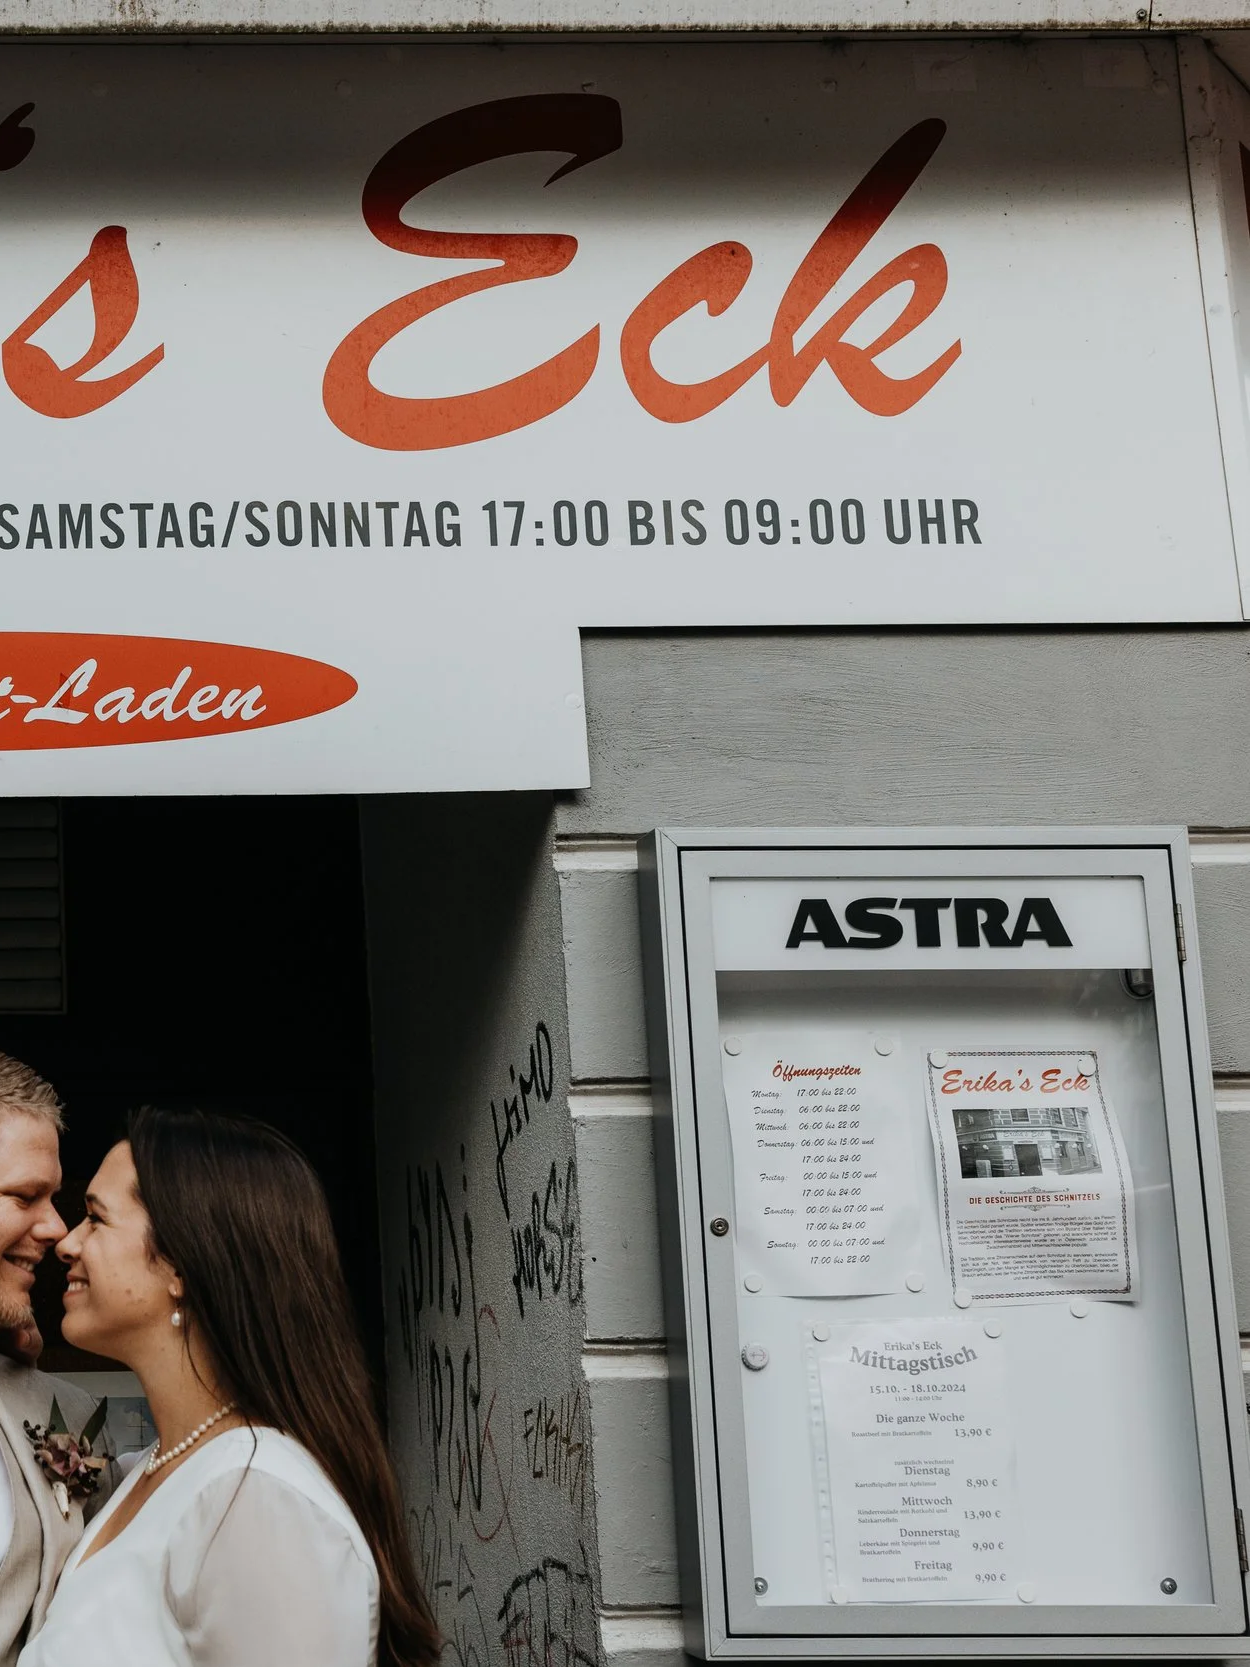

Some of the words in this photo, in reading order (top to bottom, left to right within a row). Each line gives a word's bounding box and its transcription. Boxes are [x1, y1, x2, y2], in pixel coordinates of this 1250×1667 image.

[322, 92, 962, 453] Eck
[481, 500, 608, 548] 17:00
[629, 499, 707, 547] BIS
[724, 498, 866, 547] 09:00
[884, 497, 983, 546] UHR
[785, 896, 1074, 950] ASTRA
[772, 1060, 862, 1081] Öffnungszeiten
[941, 1068, 1034, 1095] Erika's
[1040, 1068, 1091, 1094] Eck
[797, 1088, 820, 1097] 17:00
[822, 1087, 832, 1096] bis
[834, 1087, 857, 1096] 22:00
[798, 1104, 823, 1113] 06:00
[825, 1104, 836, 1113] bis
[837, 1103, 861, 1112] 22:00
[798, 1121, 823, 1130] 06:00
[825, 1120, 836, 1129] bis
[837, 1120, 860, 1129] 22:00
[801, 1137, 825, 1147] 06:00
[827, 1137, 838, 1146] bis
[862, 1137, 875, 1145] und
[802, 1154, 825, 1164] 17:00
[826, 1154, 837, 1163] bis
[803, 1171, 827, 1180] 00:00
[829, 1171, 840, 1180] bis
[864, 1171, 878, 1179] und
[802, 1188, 825, 1197] 17:00
[826, 1188, 837, 1197] bis
[969, 1197, 982, 1205] DIE
[985, 1195, 1033, 1204] GESCHICHTE
[1036, 1195, 1051, 1203] DES
[1054, 1193, 1101, 1202] SCHNITZELS
[805, 1205, 830, 1214] 00:00
[831, 1205, 842, 1214] bis
[843, 1204, 868, 1213] 07:00
[870, 1204, 885, 1212] und
[806, 1222, 828, 1231] 17:00
[829, 1221, 840, 1230] bis
[807, 1238, 831, 1248] 00:00
[833, 1238, 844, 1247] bis
[845, 1237, 870, 1247] 07:00
[872, 1237, 886, 1246] und
[810, 1255, 832, 1265] 17:00
[833, 1255, 844, 1264] bis
[846, 1254, 871, 1263] 22:00
[883, 1341, 920, 1351] Erika's
[923, 1340, 942, 1350] Eck
[849, 1345, 979, 1375] Mittagstisch
[869, 1385, 900, 1394] 15.10.
[911, 1383, 966, 1393] 18.10.2024
[876, 1414, 894, 1423] Die
[896, 1415, 926, 1425] ganze
[929, 1413, 965, 1422] Woche
[954, 1428, 982, 1438] 13,90
[985, 1428, 992, 1436] €
[904, 1466, 951, 1477] Dienstag
[966, 1479, 989, 1488] 8,90
[992, 1478, 999, 1487] €
[901, 1496, 953, 1506] Mittwoch
[964, 1510, 992, 1520] 13,90
[995, 1510, 1002, 1518] €
[899, 1528, 960, 1539] Donnerstag
[972, 1541, 995, 1551] 9,90
[998, 1541, 1005, 1550] €
[914, 1560, 952, 1571] Freitag
[975, 1573, 997, 1583] 9,90
[1000, 1573, 1007, 1582] €
